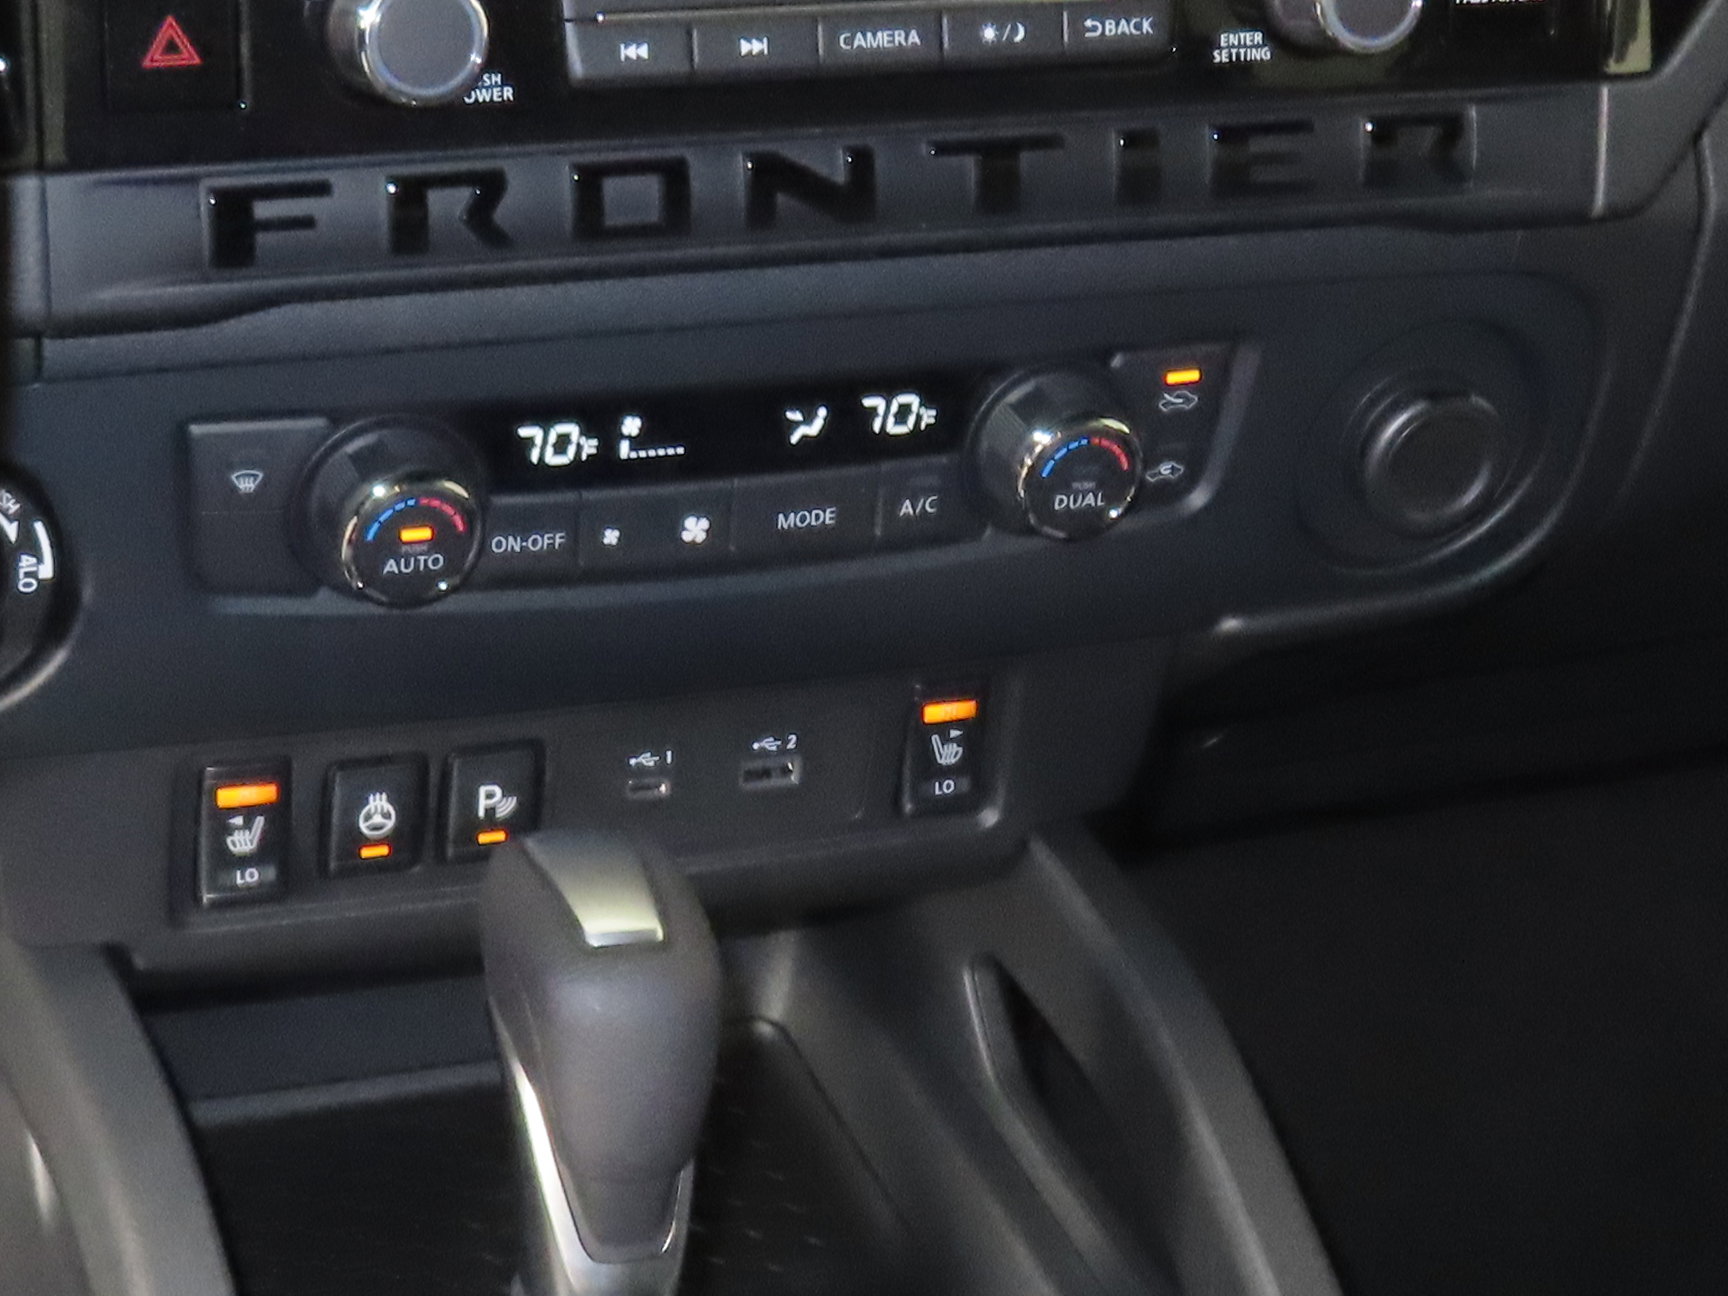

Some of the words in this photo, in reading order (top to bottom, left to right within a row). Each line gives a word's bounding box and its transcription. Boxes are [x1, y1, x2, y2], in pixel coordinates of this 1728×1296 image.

[1104, 17, 1154, 36] BACK
[839, 29, 921, 50] CAMERA
[1219, 31, 1263, 48] ENTER
[1213, 46, 1271, 63] SETTING
[204, 111, 1476, 269] FRONTIER
[899, 495, 939, 517] A/C
[1054, 491, 1105, 510] DUAL
[777, 508, 837, 530] MODE
[491, 532, 566, 554] ON-OFF
[383, 553, 444, 575] AUTO
[786, 734, 797, 749] 2
[665, 750, 672, 764] 1
[934, 780, 955, 795] LO
[477, 783, 503, 820] P
[236, 867, 259, 884] LO
